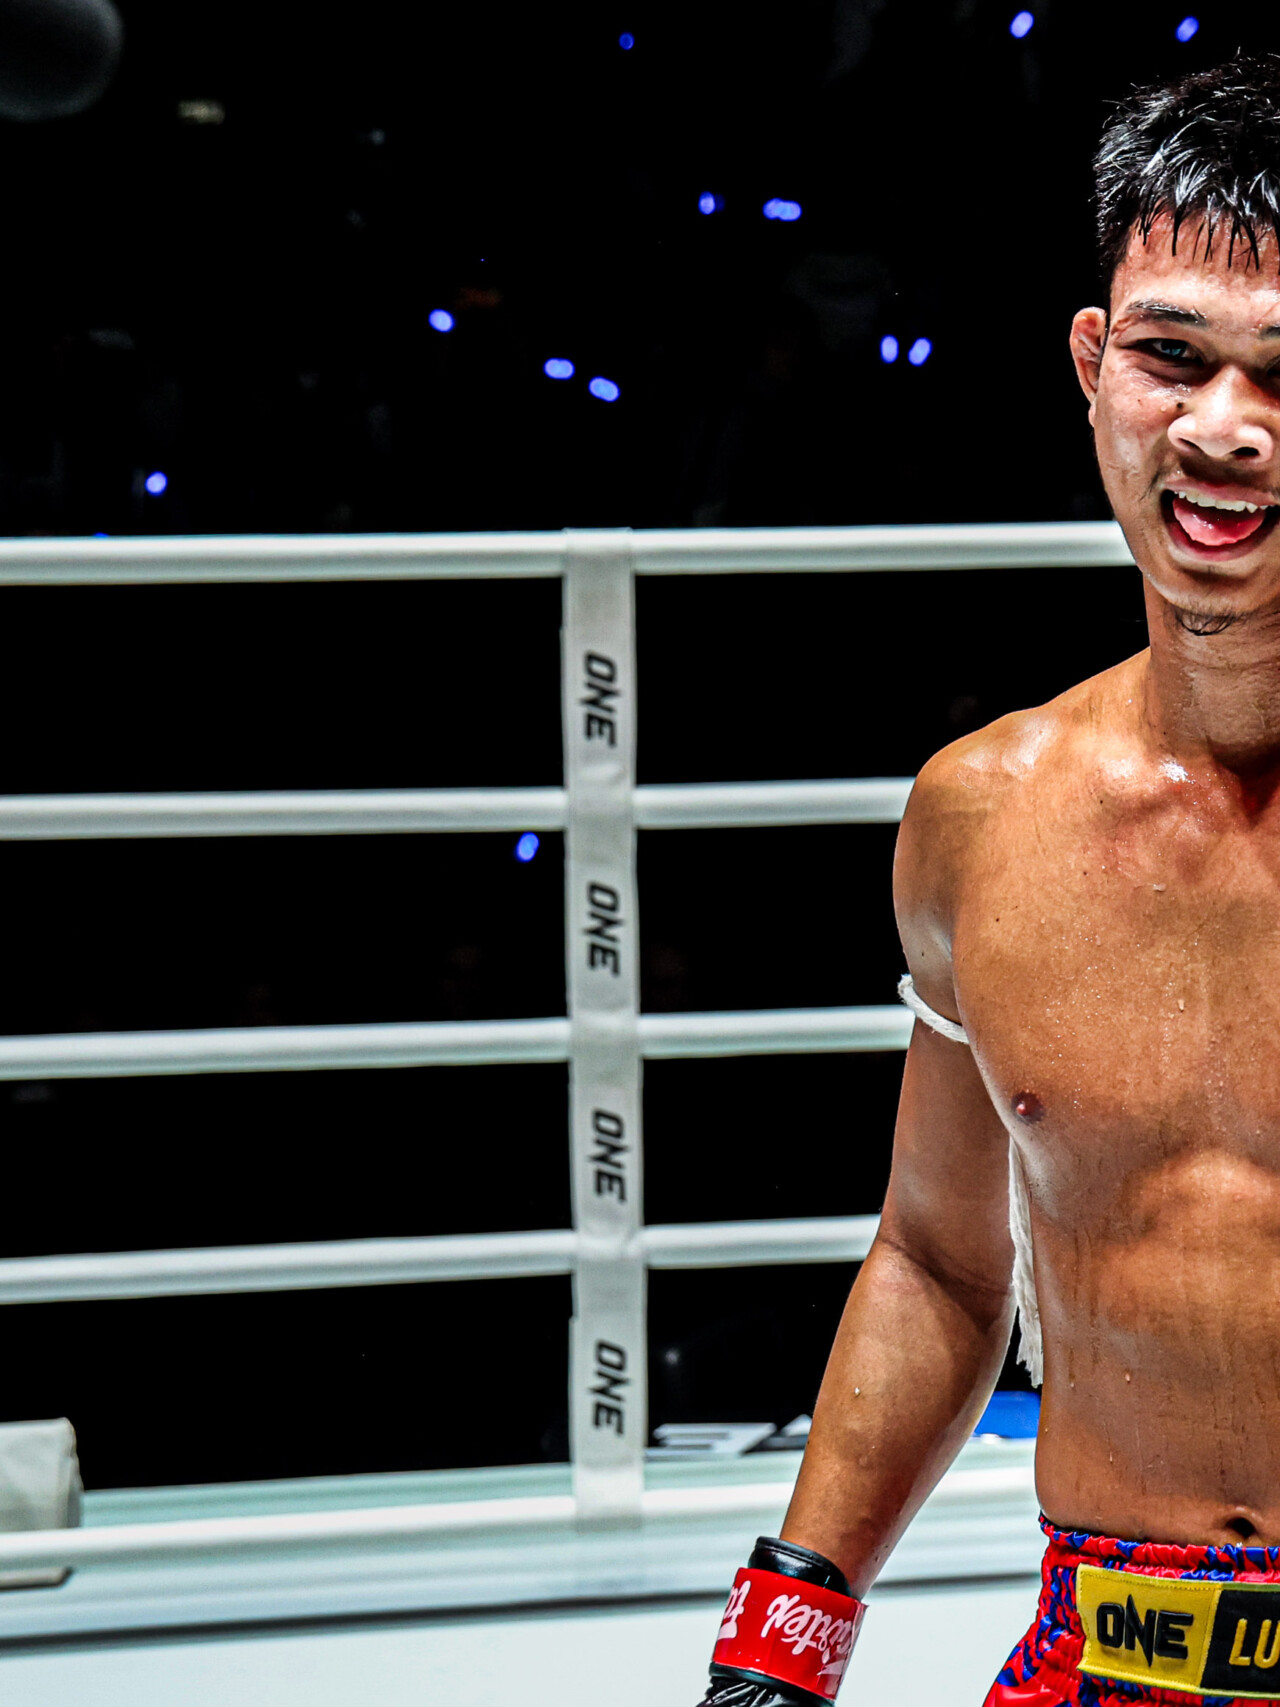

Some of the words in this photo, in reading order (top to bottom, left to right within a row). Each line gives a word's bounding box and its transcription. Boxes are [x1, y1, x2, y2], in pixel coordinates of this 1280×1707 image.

[580, 650, 620, 749] ONE
[582, 881, 623, 977] ONE
[589, 1107, 631, 1205] ONE
[588, 1339, 631, 1437] ONE
[1096, 1594, 1194, 1668] ONE
